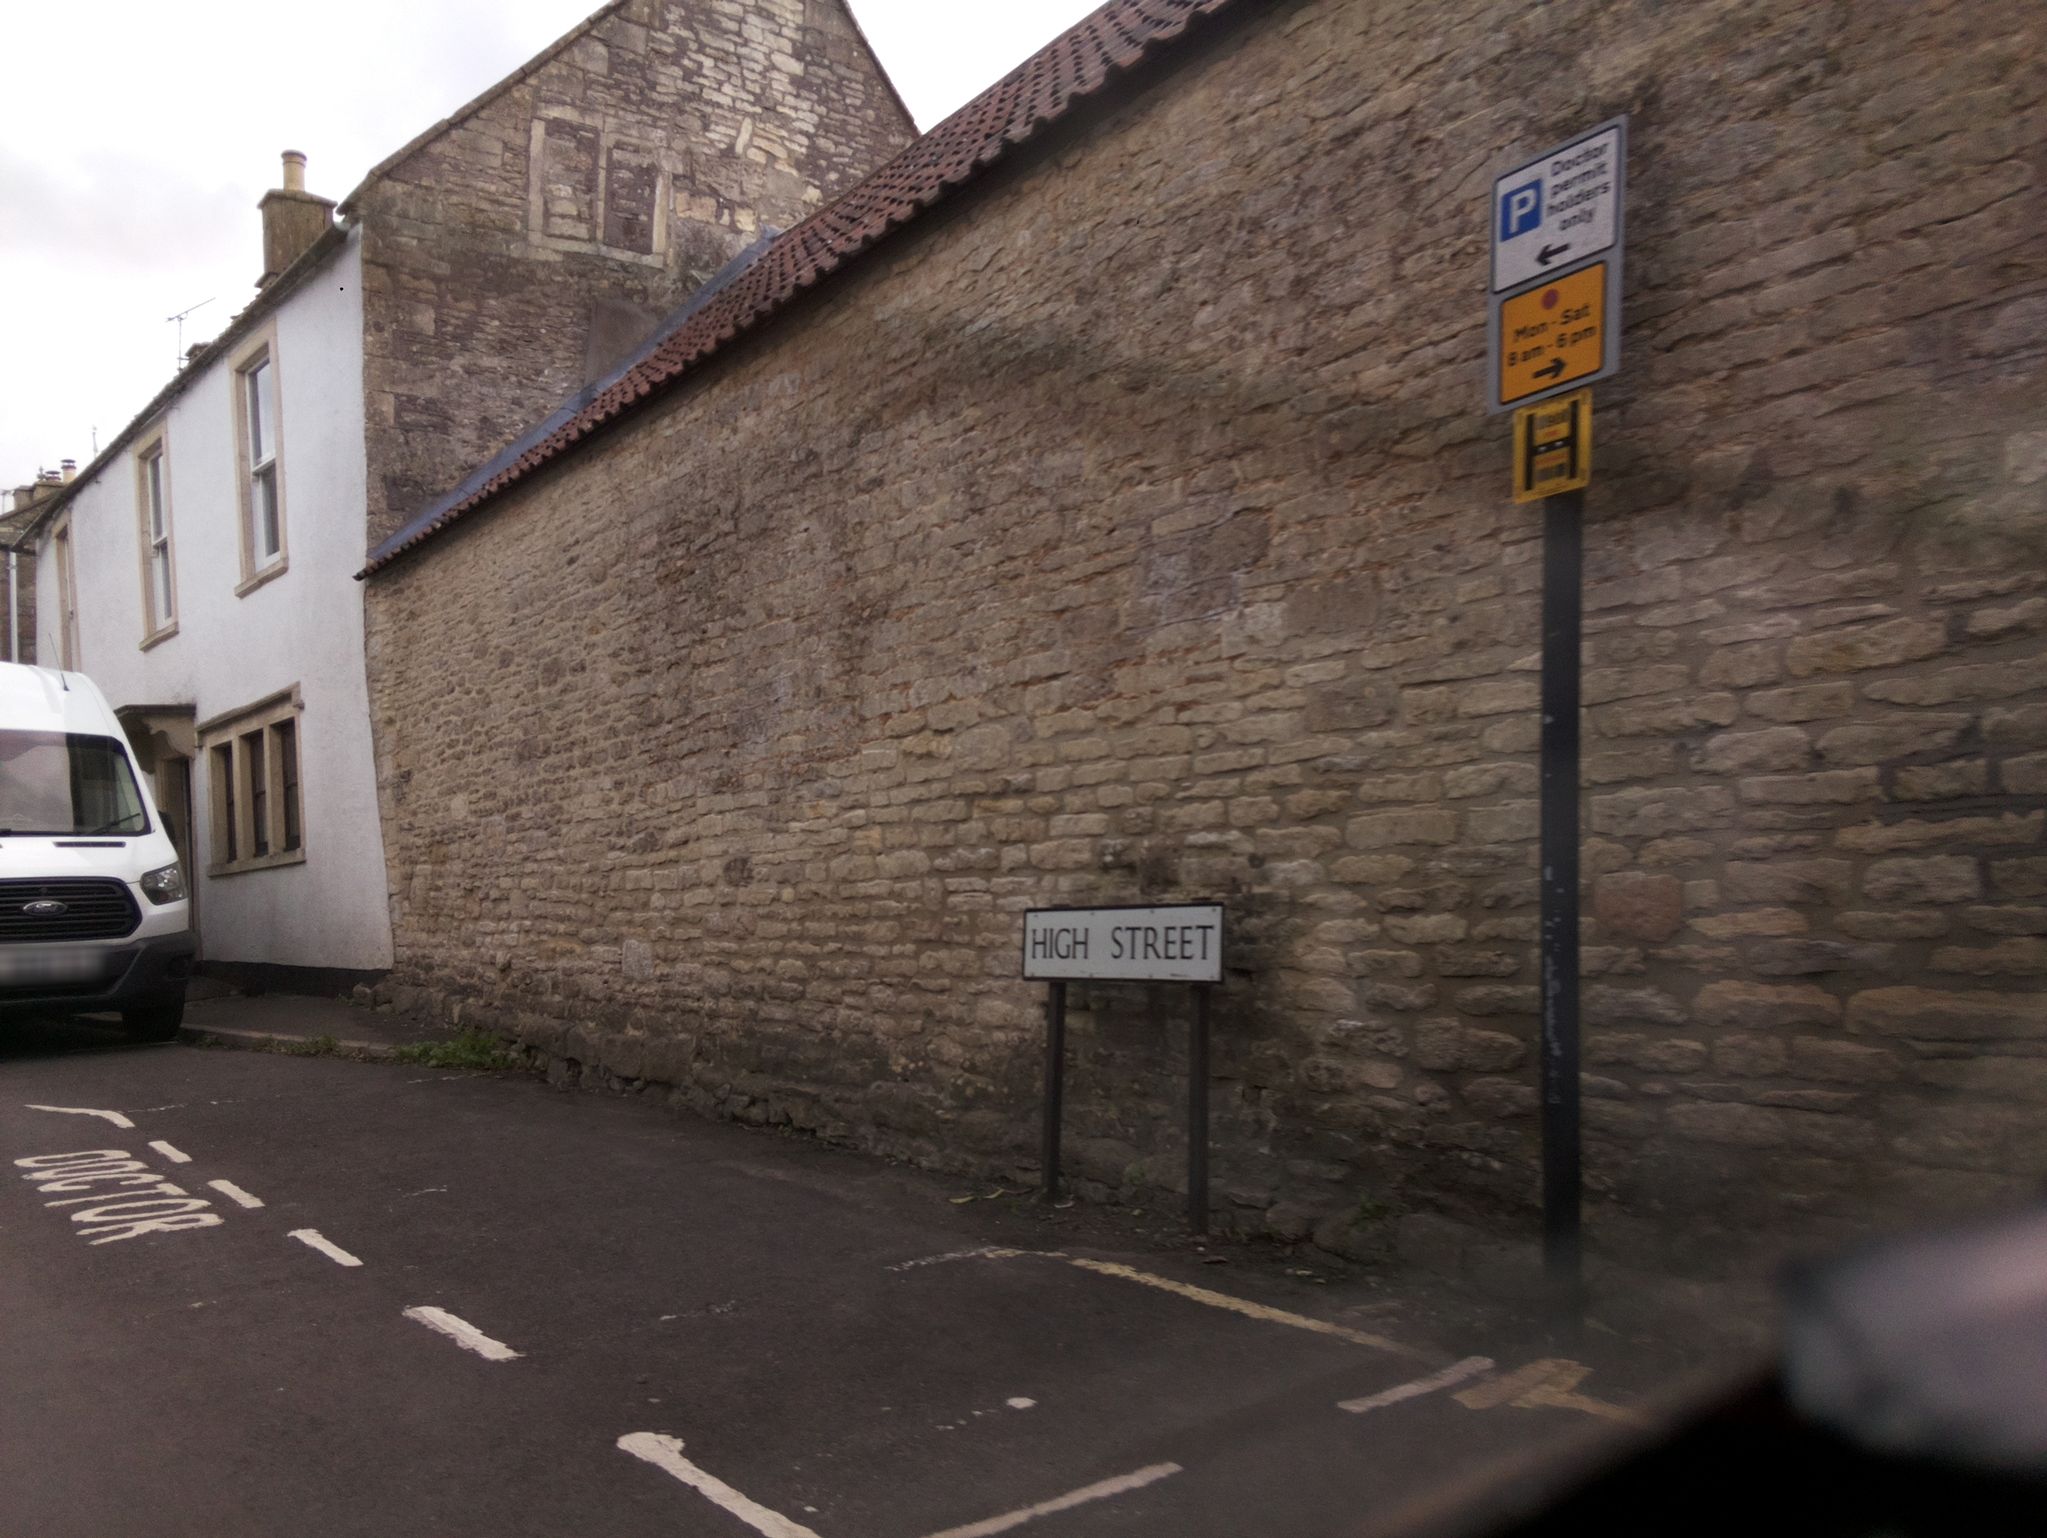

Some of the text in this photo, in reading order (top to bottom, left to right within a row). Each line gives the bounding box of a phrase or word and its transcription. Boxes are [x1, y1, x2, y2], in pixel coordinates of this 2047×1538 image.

[1509, 188, 1537, 234] P
[1031, 924, 1215, 960] HIGH STREET
[13, 1149, 225, 1246] DOCTOR
